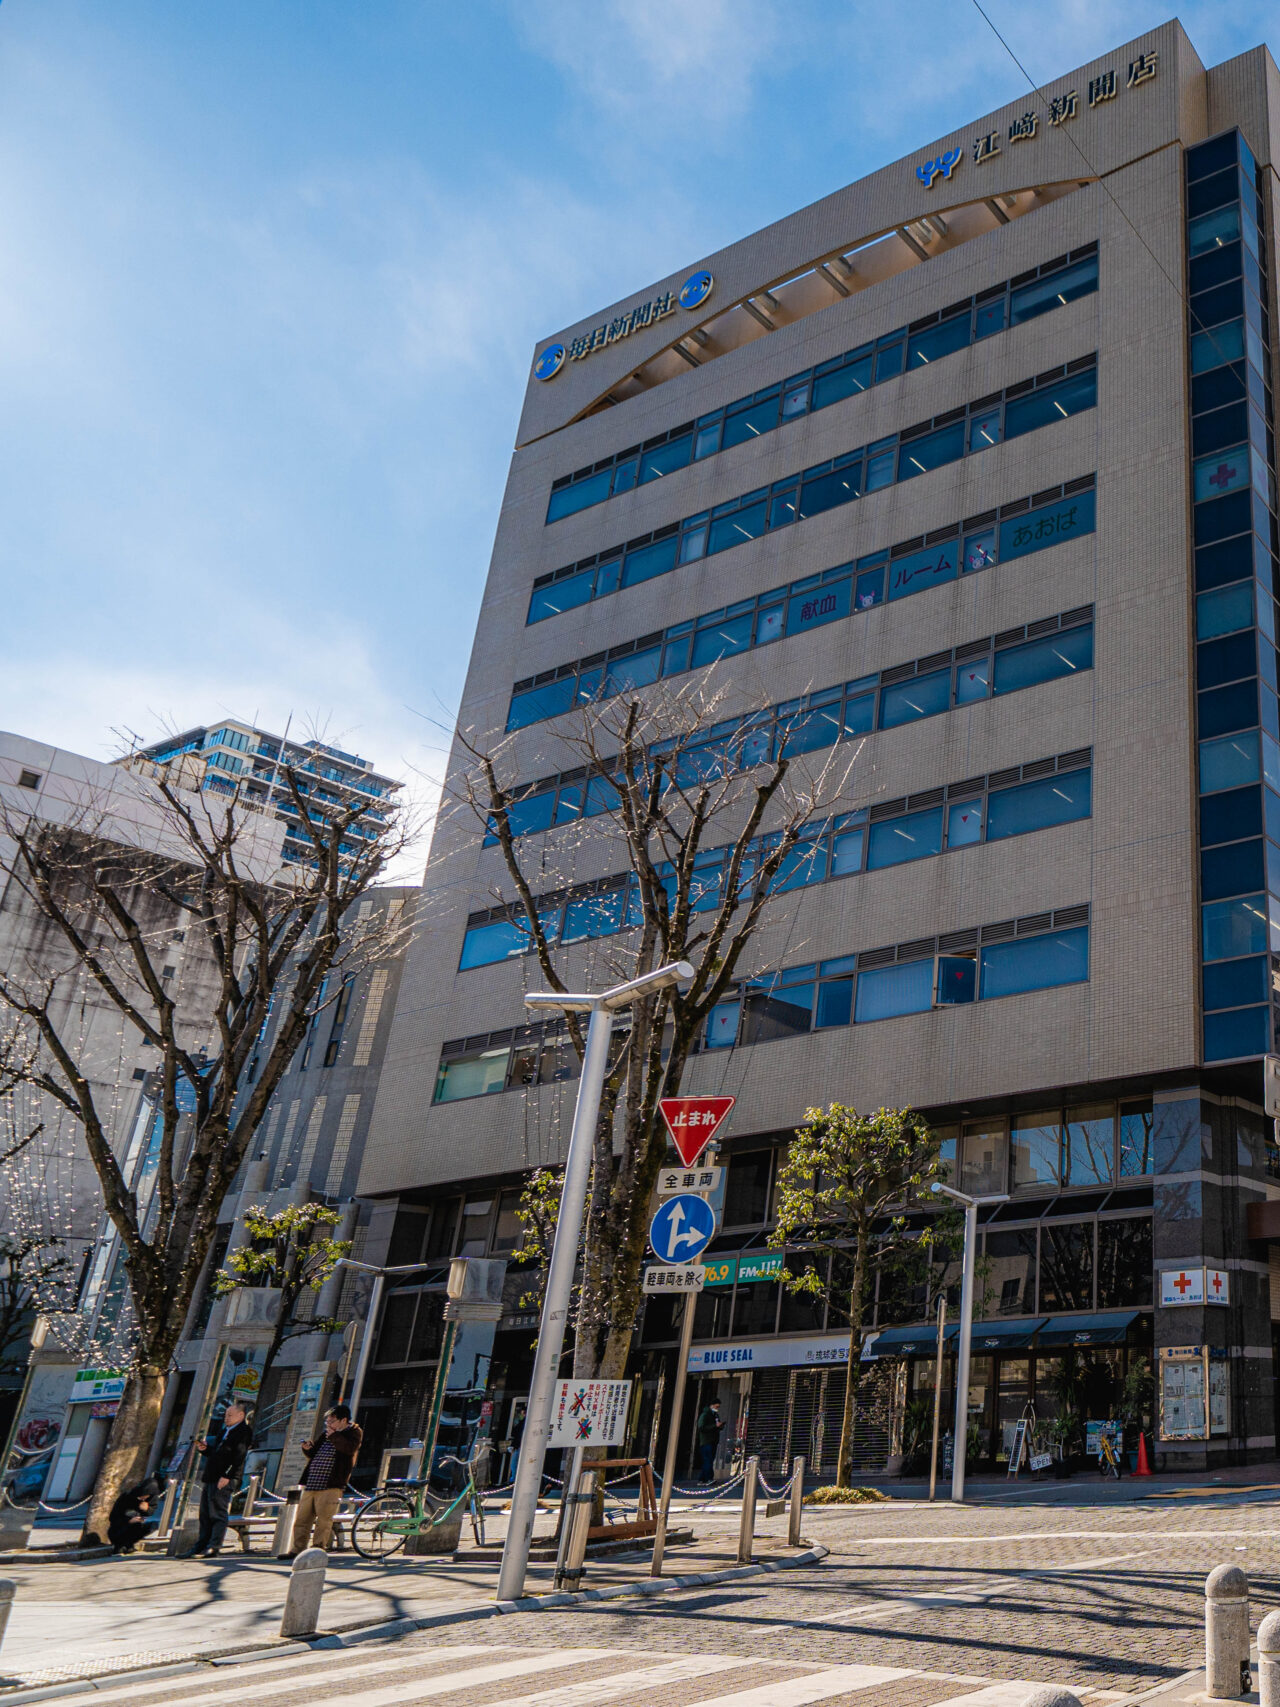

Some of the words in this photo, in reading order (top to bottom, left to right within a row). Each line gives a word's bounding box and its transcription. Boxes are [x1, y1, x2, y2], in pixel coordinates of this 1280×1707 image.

[569, 291, 677, 361] 毎日新聞社
[800, 595, 837, 622] 献血
[894, 555, 952, 588] ルーム
[1012, 506, 1078, 547] あおば
[672, 1110, 716, 1127] 止まれ
[664, 1172, 714, 1188] 全車両
[646, 1271, 702, 1287] 軽車両を除く
[704, 1351, 728, 1364] BLUE
[730, 1349, 753, 1362] SEAL
[1032, 1457, 1051, 1469] OPEN
